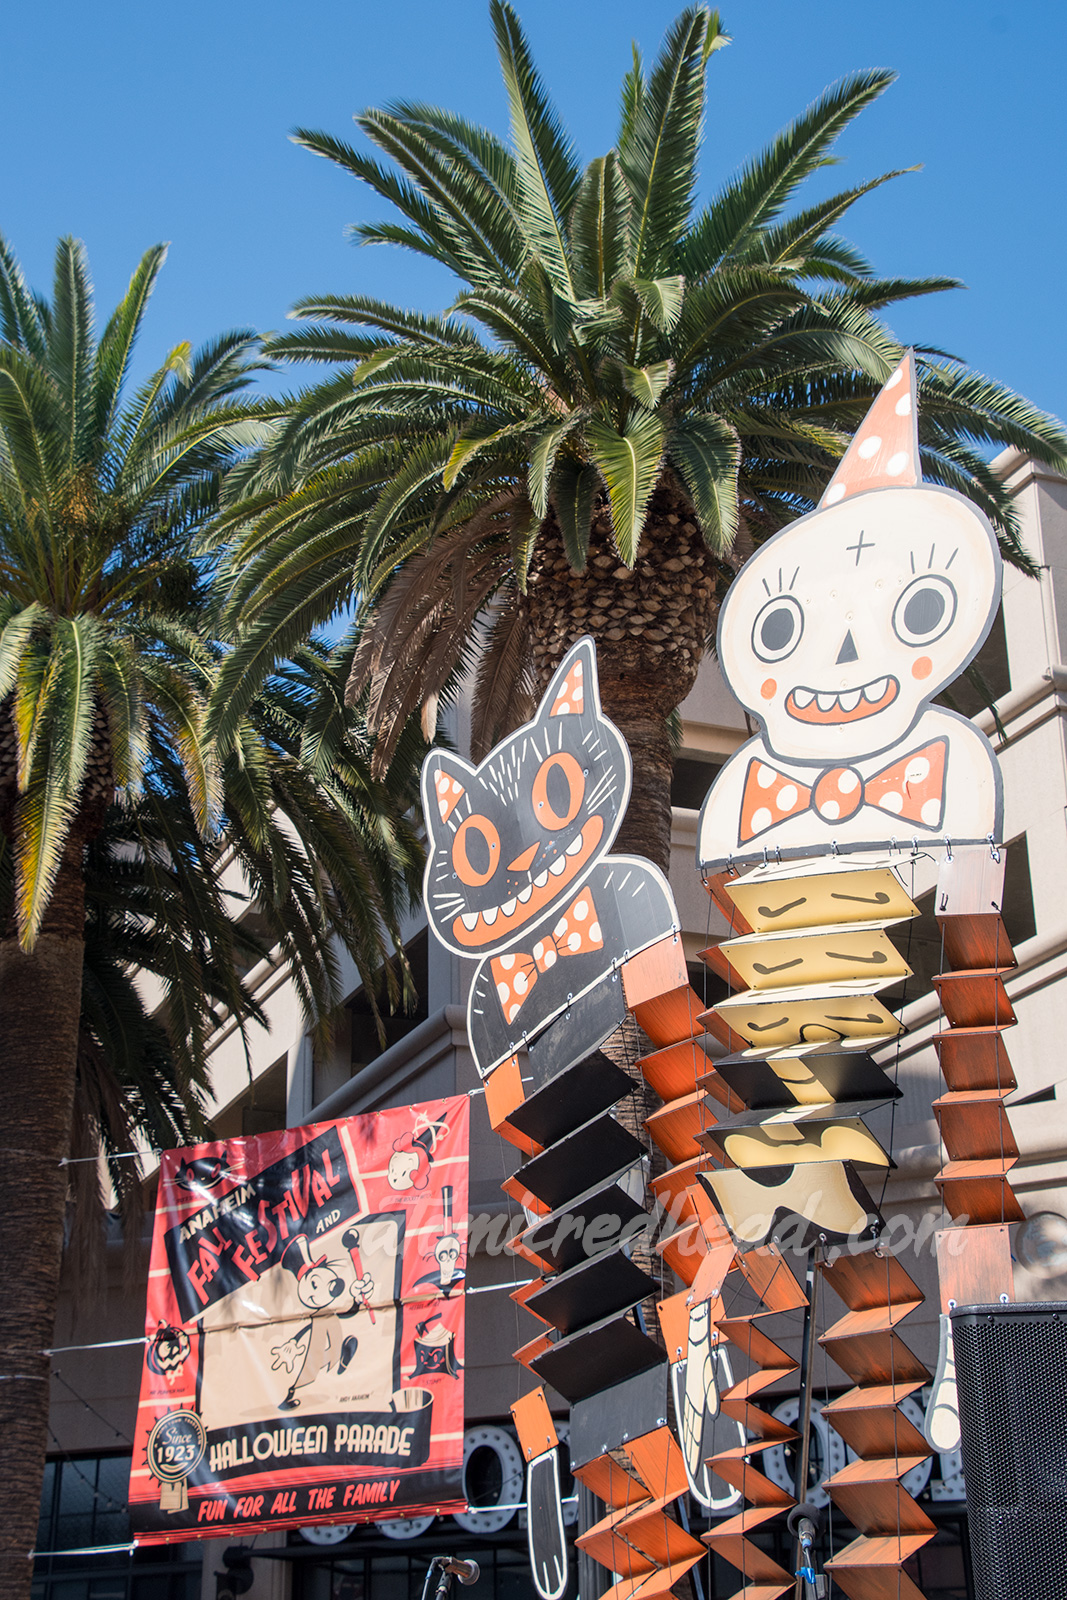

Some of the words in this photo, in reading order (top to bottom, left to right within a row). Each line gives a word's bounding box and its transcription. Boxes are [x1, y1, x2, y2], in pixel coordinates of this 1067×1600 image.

[179, 1183, 257, 1244] ANAHEIM
[231, 1148, 341, 1282] FESTIVAL
[315, 1209, 341, 1234] AND
[186, 1226, 233, 1306] FALL
[157, 1444, 196, 1464] 1923
[162, 1426, 193, 1446] Since
[209, 1425, 328, 1472] HALLOWEEN
[334, 1424, 415, 1456] PARADE
[197, 1499, 228, 1522] FUN
[233, 1494, 264, 1518] FOR
[270, 1491, 297, 1514] ALL
[308, 1486, 337, 1510] THE
[343, 1479, 400, 1506] FAMILY
